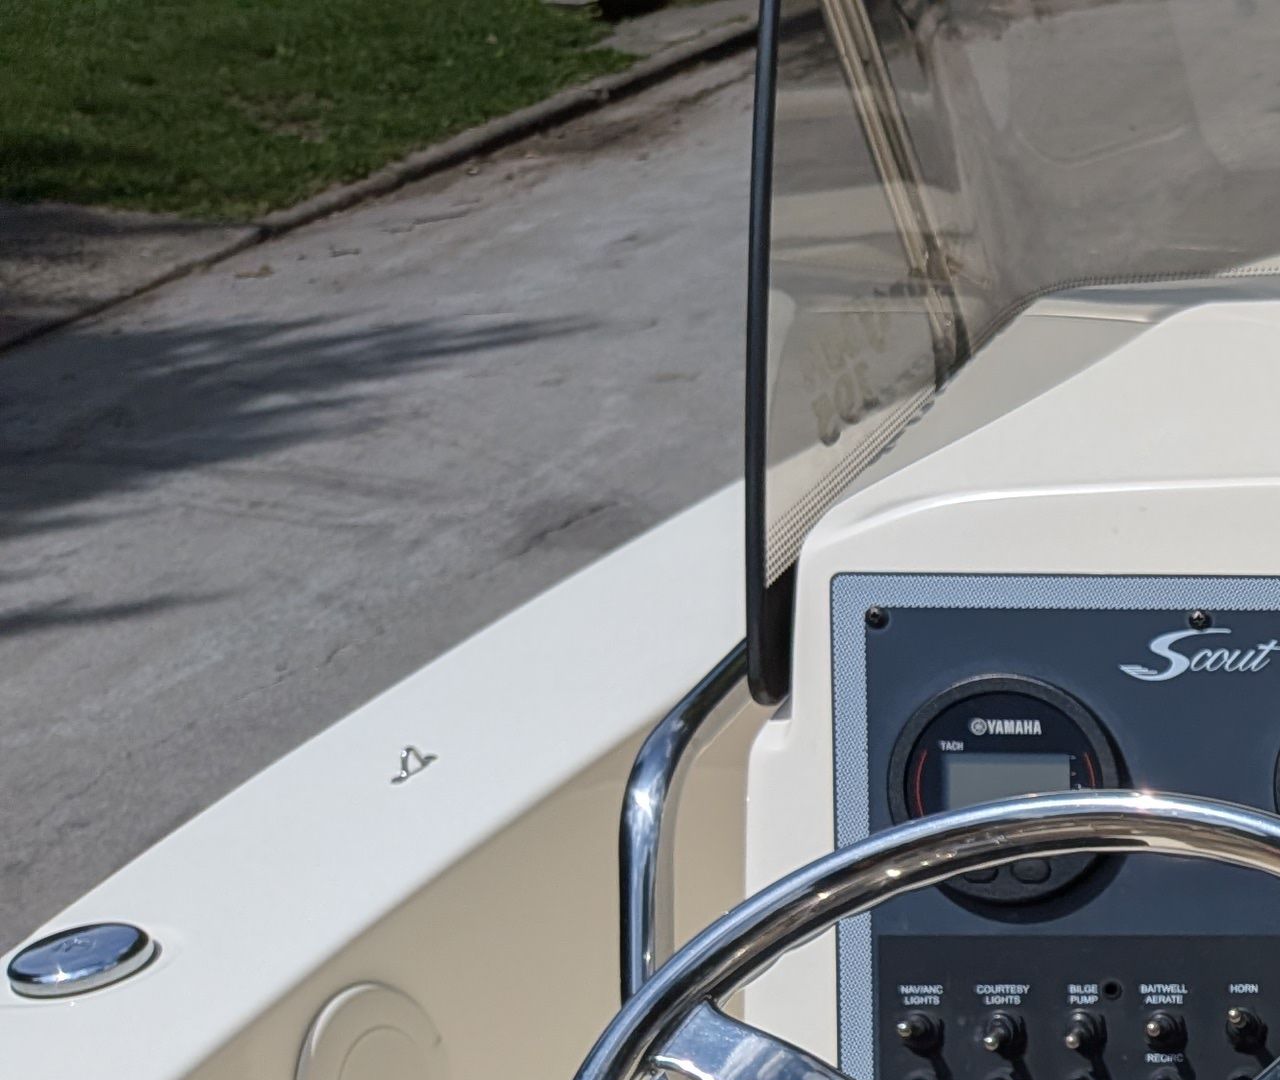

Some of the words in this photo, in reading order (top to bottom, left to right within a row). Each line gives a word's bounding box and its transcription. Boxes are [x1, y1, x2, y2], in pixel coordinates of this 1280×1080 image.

[988, 720, 1042, 735] YAMAHA
[940, 741, 964, 751] TACH
[976, 985, 1030, 994] COURTESY
[1069, 985, 1098, 994] BILGE
[1140, 984, 1188, 994] BAITWELL
[1230, 984, 1258, 993] HORN
[905, 996, 940, 1005] LIGHTS
[986, 996, 1021, 1005] LIGHTS
[1070, 995, 1099, 1004] PUMP
[1145, 995, 1183, 1004] AERATE
